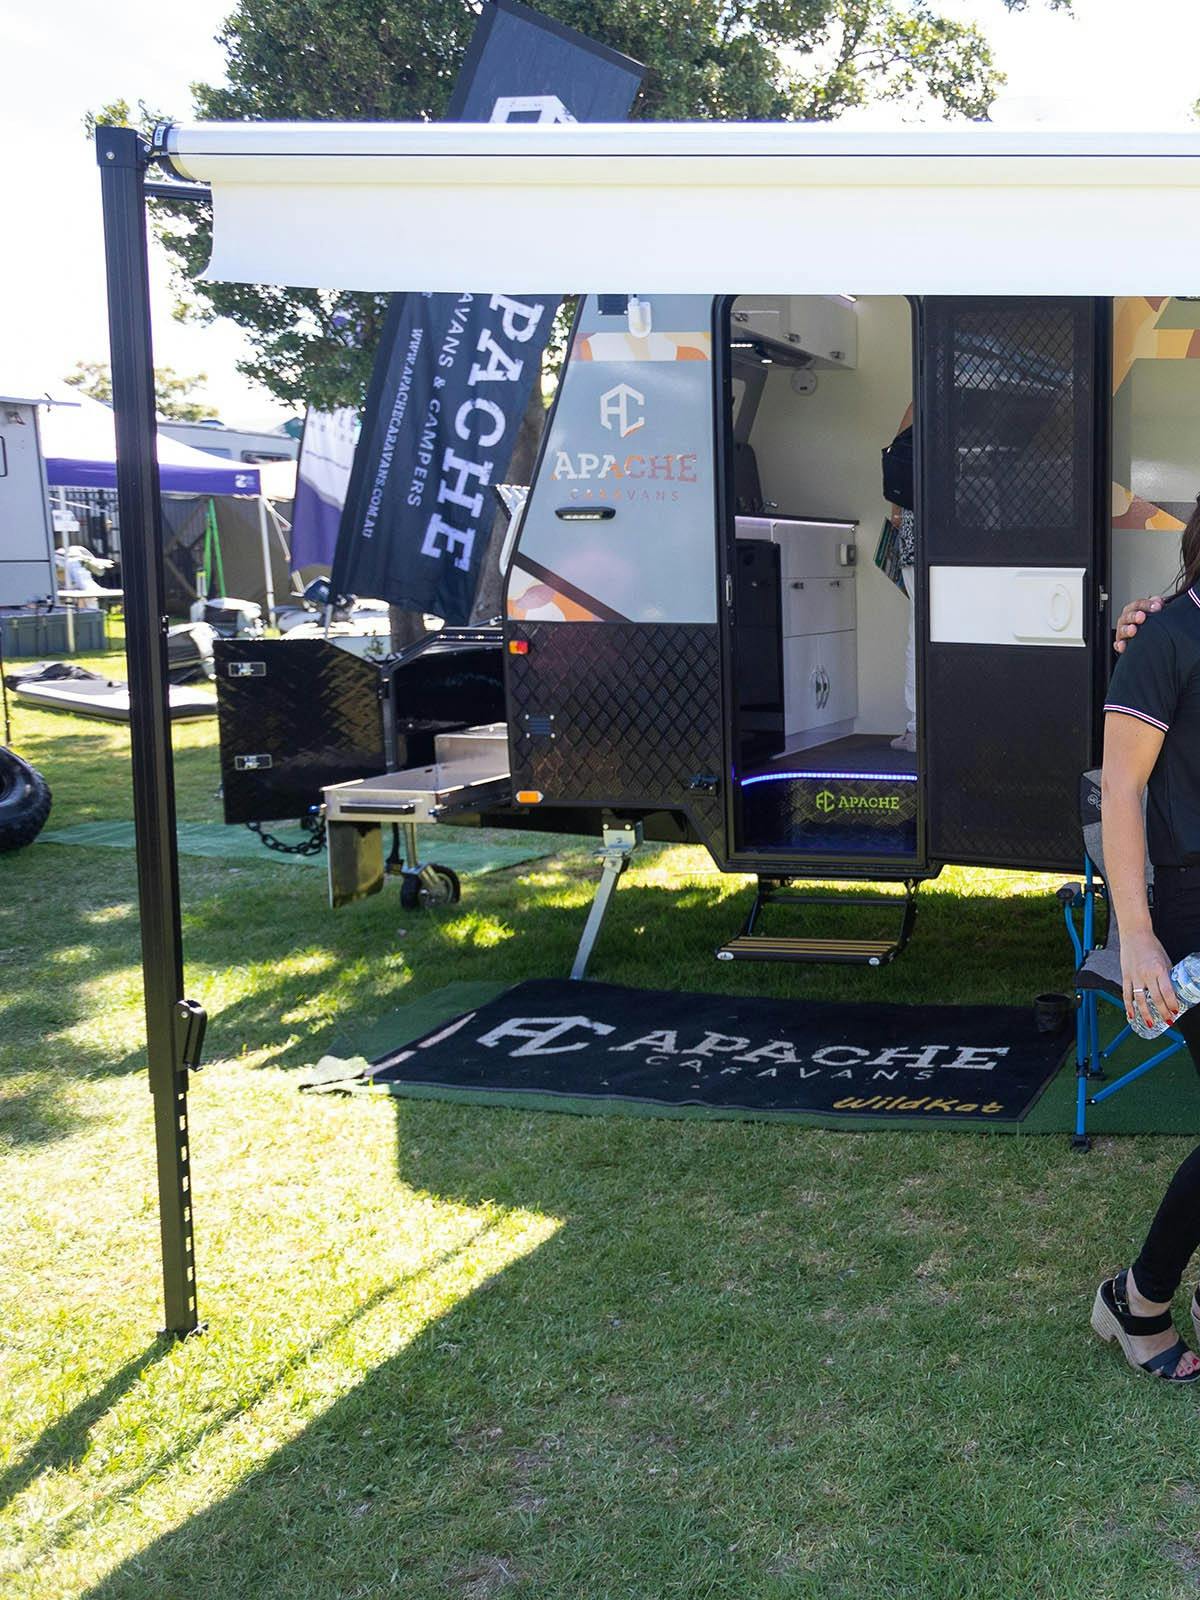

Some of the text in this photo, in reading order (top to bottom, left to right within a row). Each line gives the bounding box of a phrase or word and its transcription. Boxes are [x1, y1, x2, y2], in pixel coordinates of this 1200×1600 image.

[406, 293, 474, 507] AVANS & CAMPERS
[361, 327, 424, 540] WWW.APACHECARAVANS.COM.AU
[421, 292, 545, 572] PACHE
[550, 451, 698, 482] APACHE
[569, 488, 680, 502] CARAVANS
[838, 795, 900, 810] APACHE
[608, 1029, 1010, 1071] APACHE
[644, 1055, 935, 1081] CARAVANS
[832, 1095, 1004, 1114] WildKat
